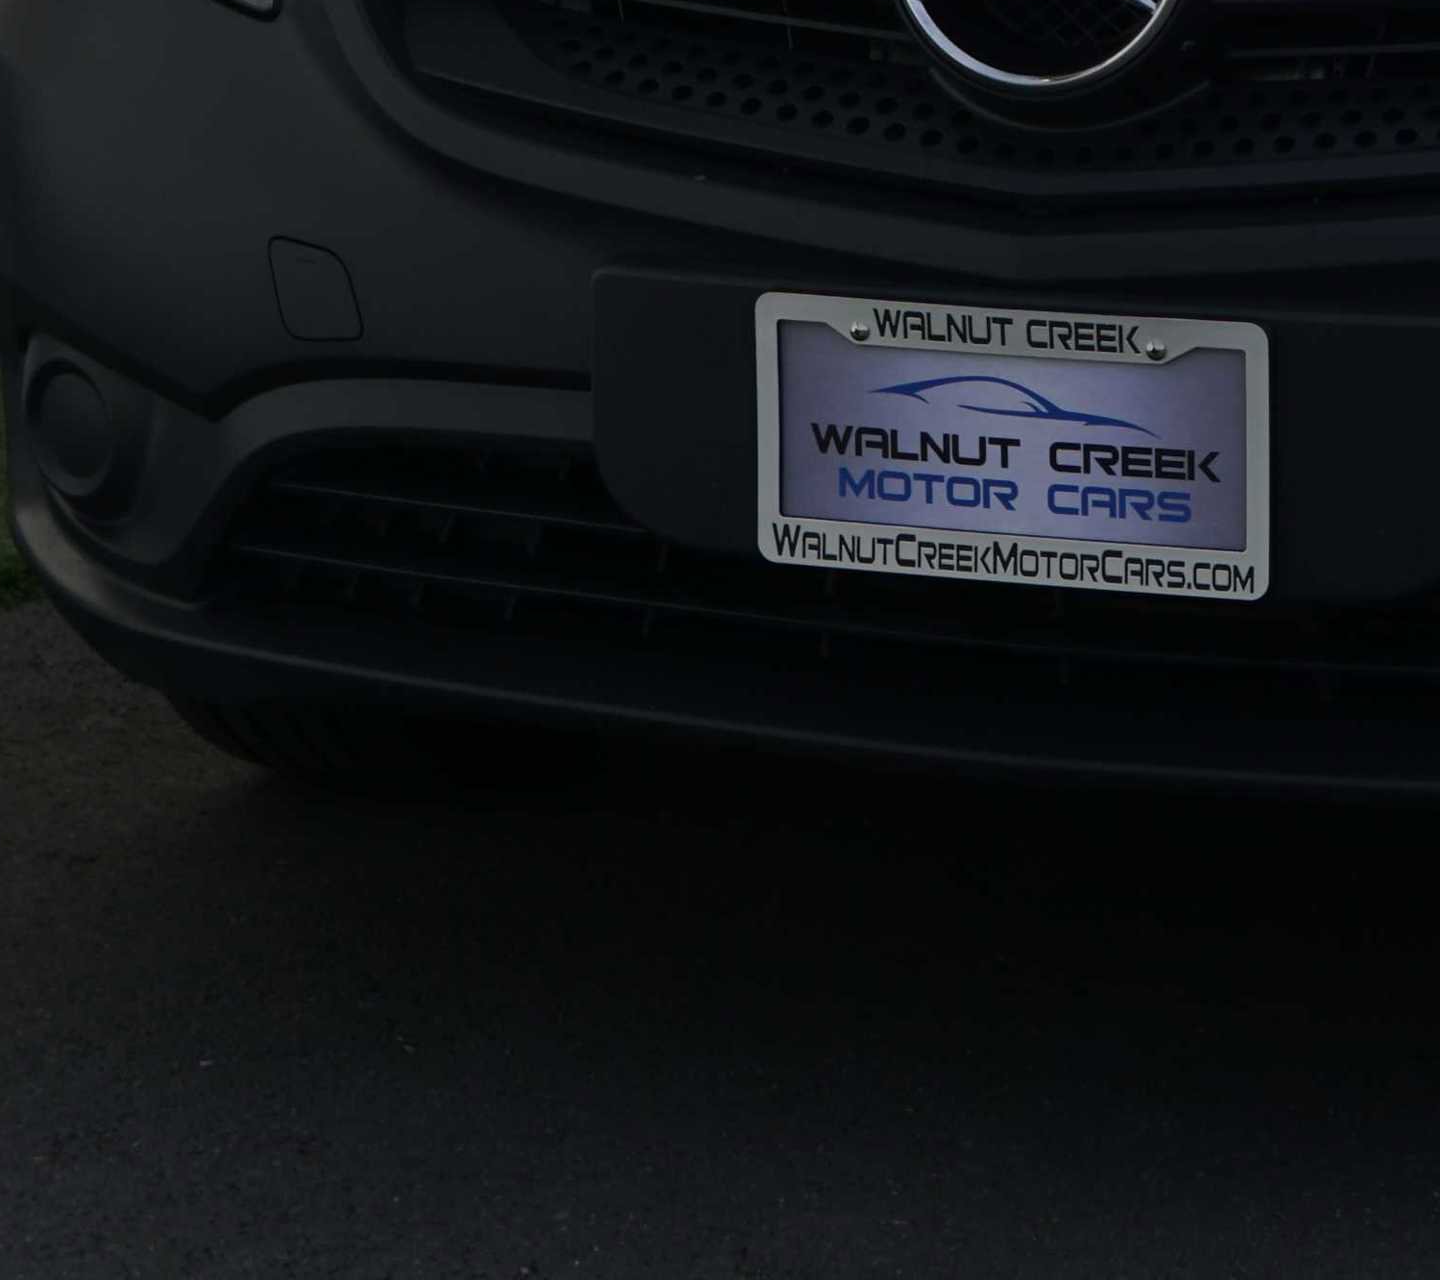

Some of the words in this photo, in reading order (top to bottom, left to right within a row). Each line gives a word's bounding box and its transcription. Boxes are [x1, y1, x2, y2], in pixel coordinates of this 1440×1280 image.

[872, 306, 1014, 347] WALNUT
[1025, 318, 1141, 355] CREEK
[810, 422, 1021, 469] WALNUT
[1048, 441, 1222, 483] CREEK
[837, 466, 1020, 511] MOTOR
[1047, 483, 1192, 524] CARS
